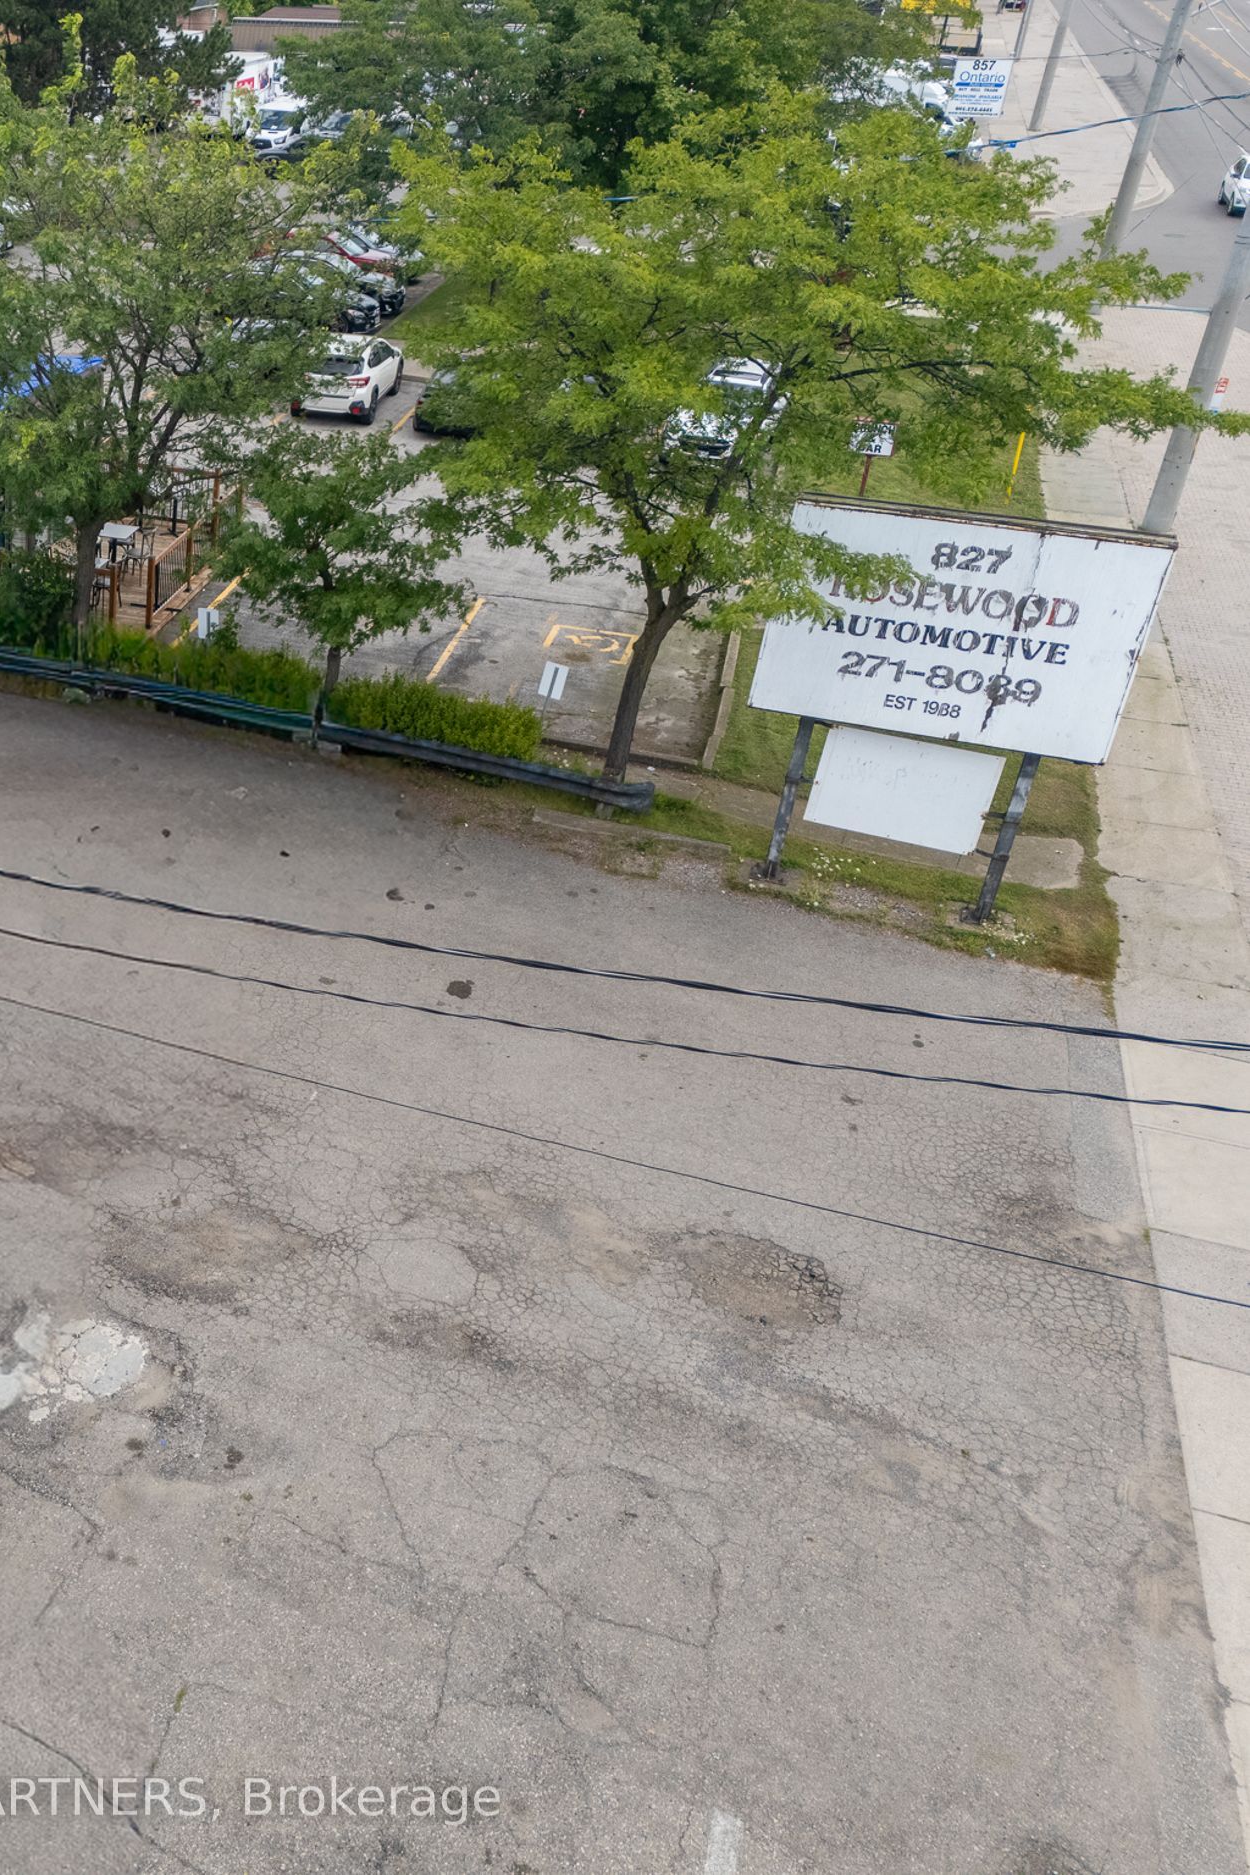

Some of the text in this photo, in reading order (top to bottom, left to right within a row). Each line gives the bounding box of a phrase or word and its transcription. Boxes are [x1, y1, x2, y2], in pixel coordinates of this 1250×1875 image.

[959, 70, 1006, 82] Ontario
[973, 59, 996, 71] 857
[931, 541, 1013, 574] 827
[822, 614, 1070, 665] AUTOMOTIVE
[883, 693, 962, 719] EST 1988
